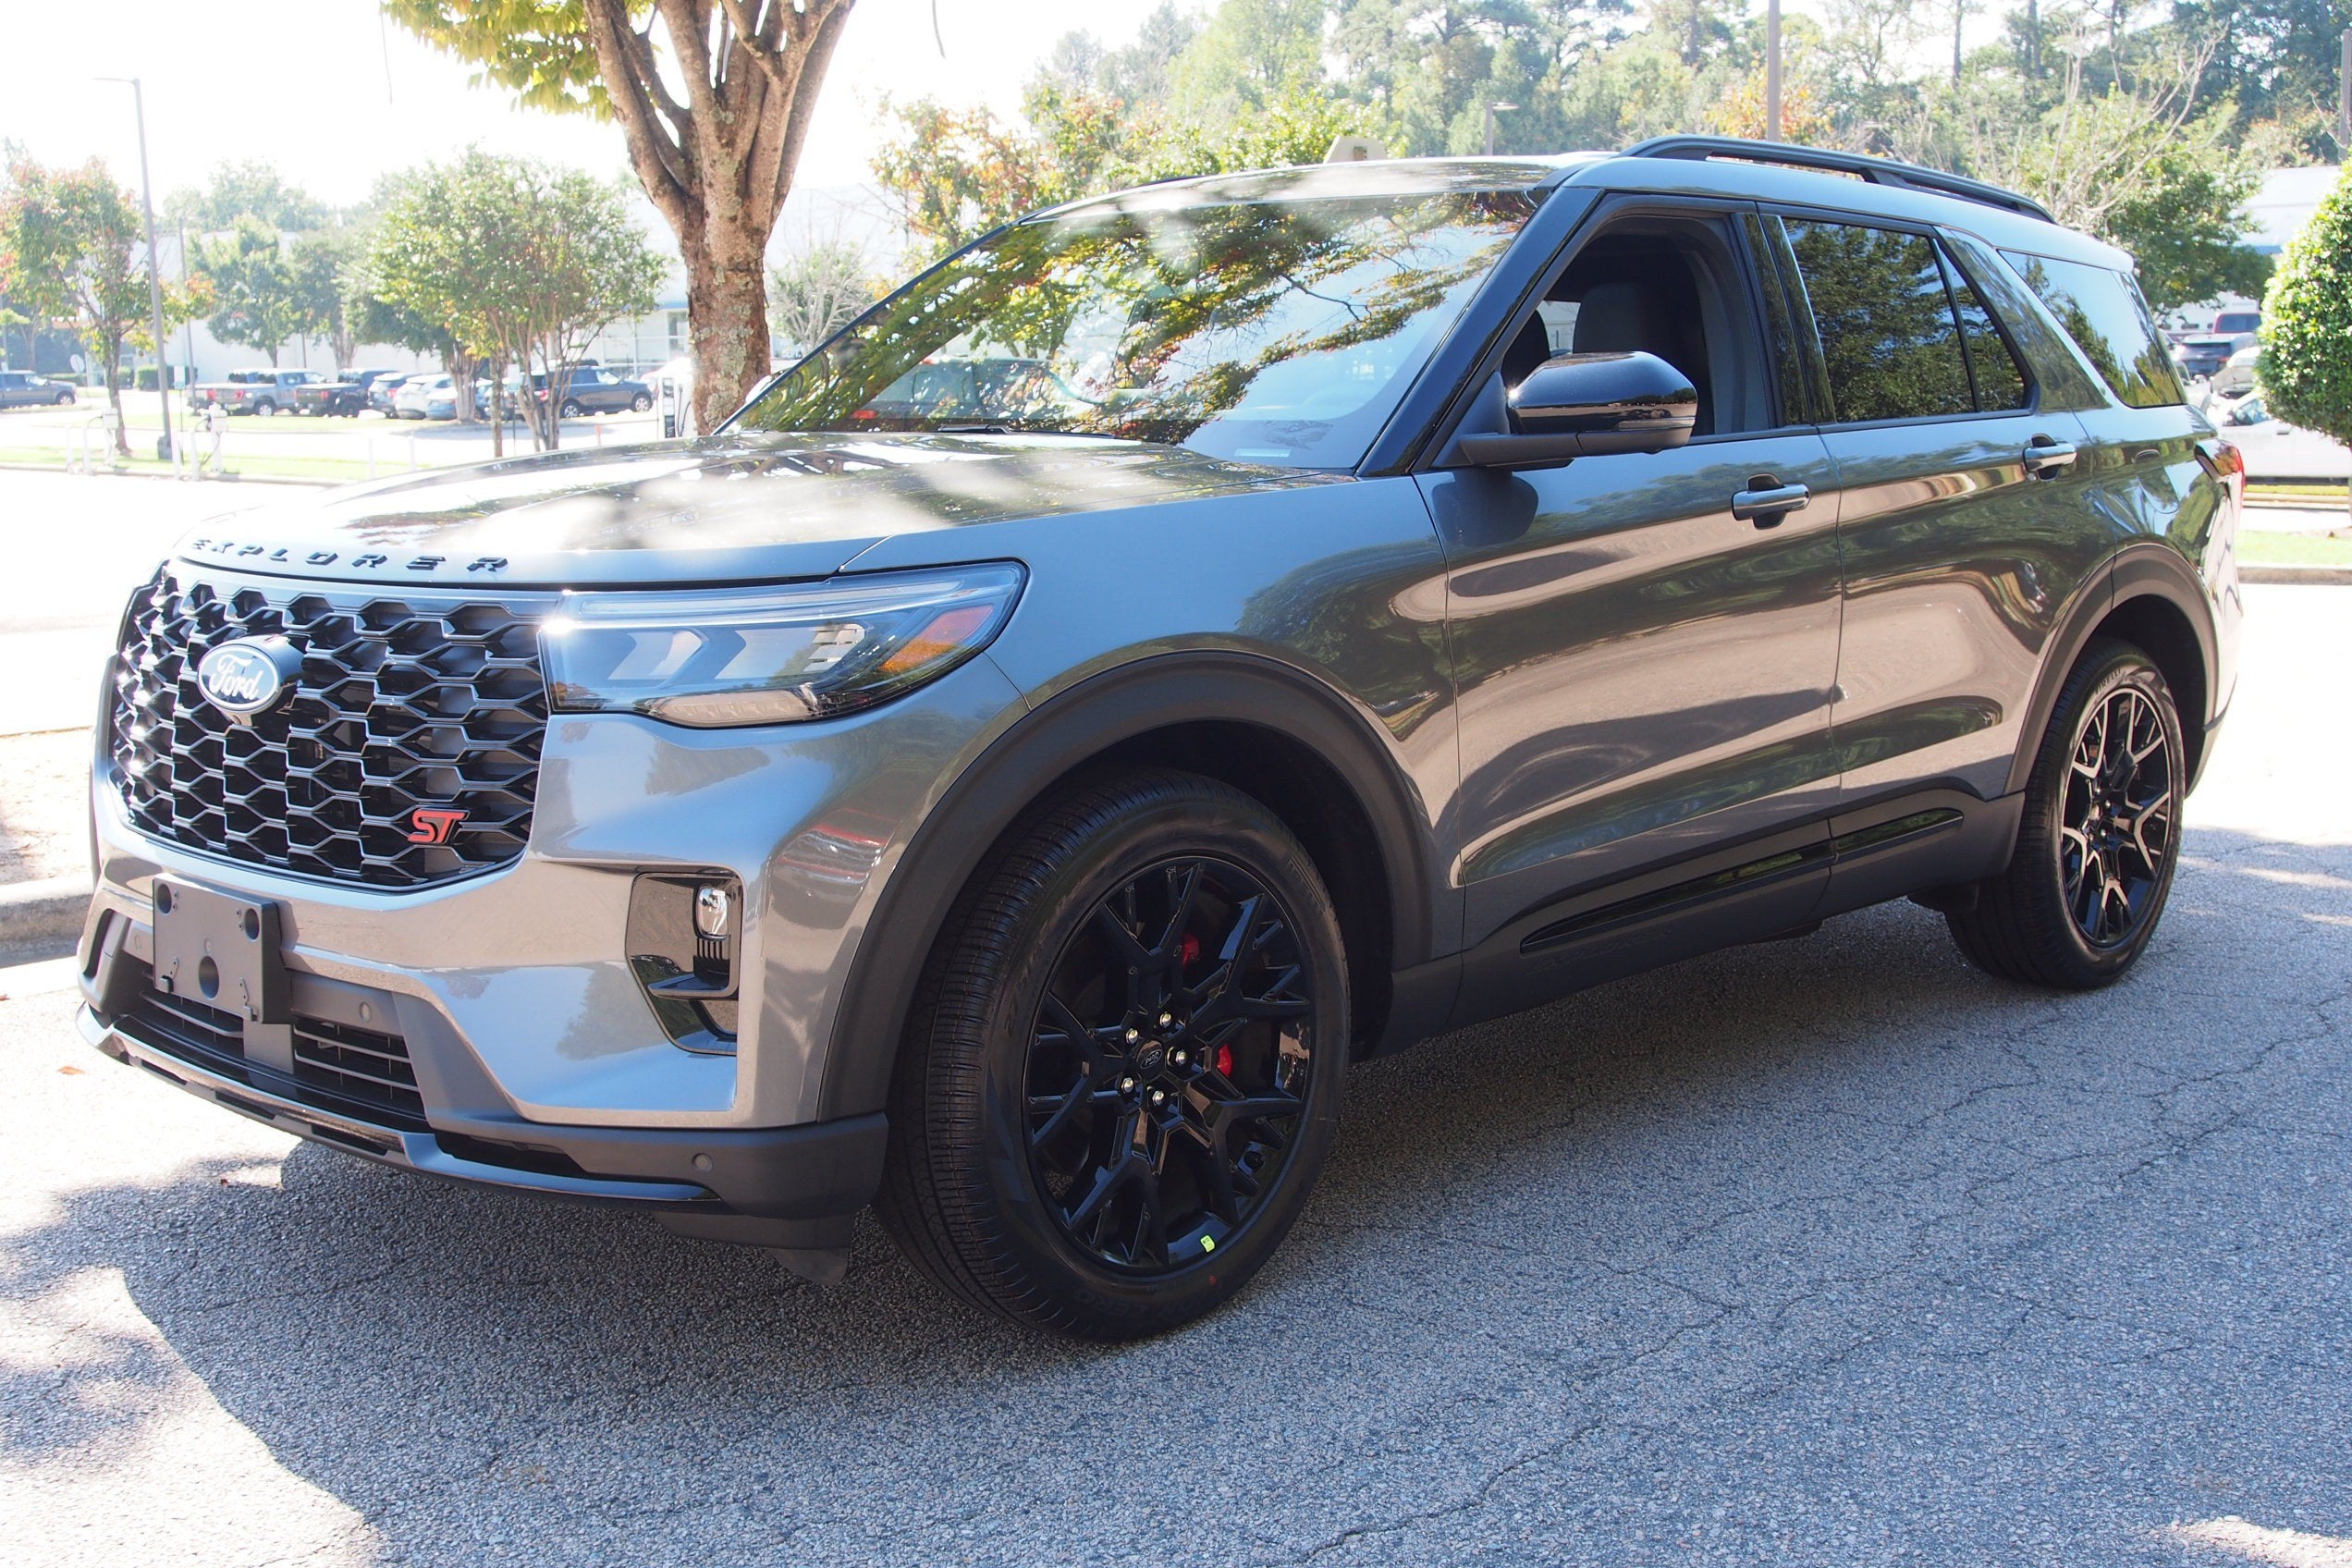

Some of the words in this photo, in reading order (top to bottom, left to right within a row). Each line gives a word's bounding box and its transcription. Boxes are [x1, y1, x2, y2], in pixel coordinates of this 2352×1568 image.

[190, 538, 508, 572] EXPLORER
[208, 653, 264, 701] Ford
[407, 809, 468, 843] ST
